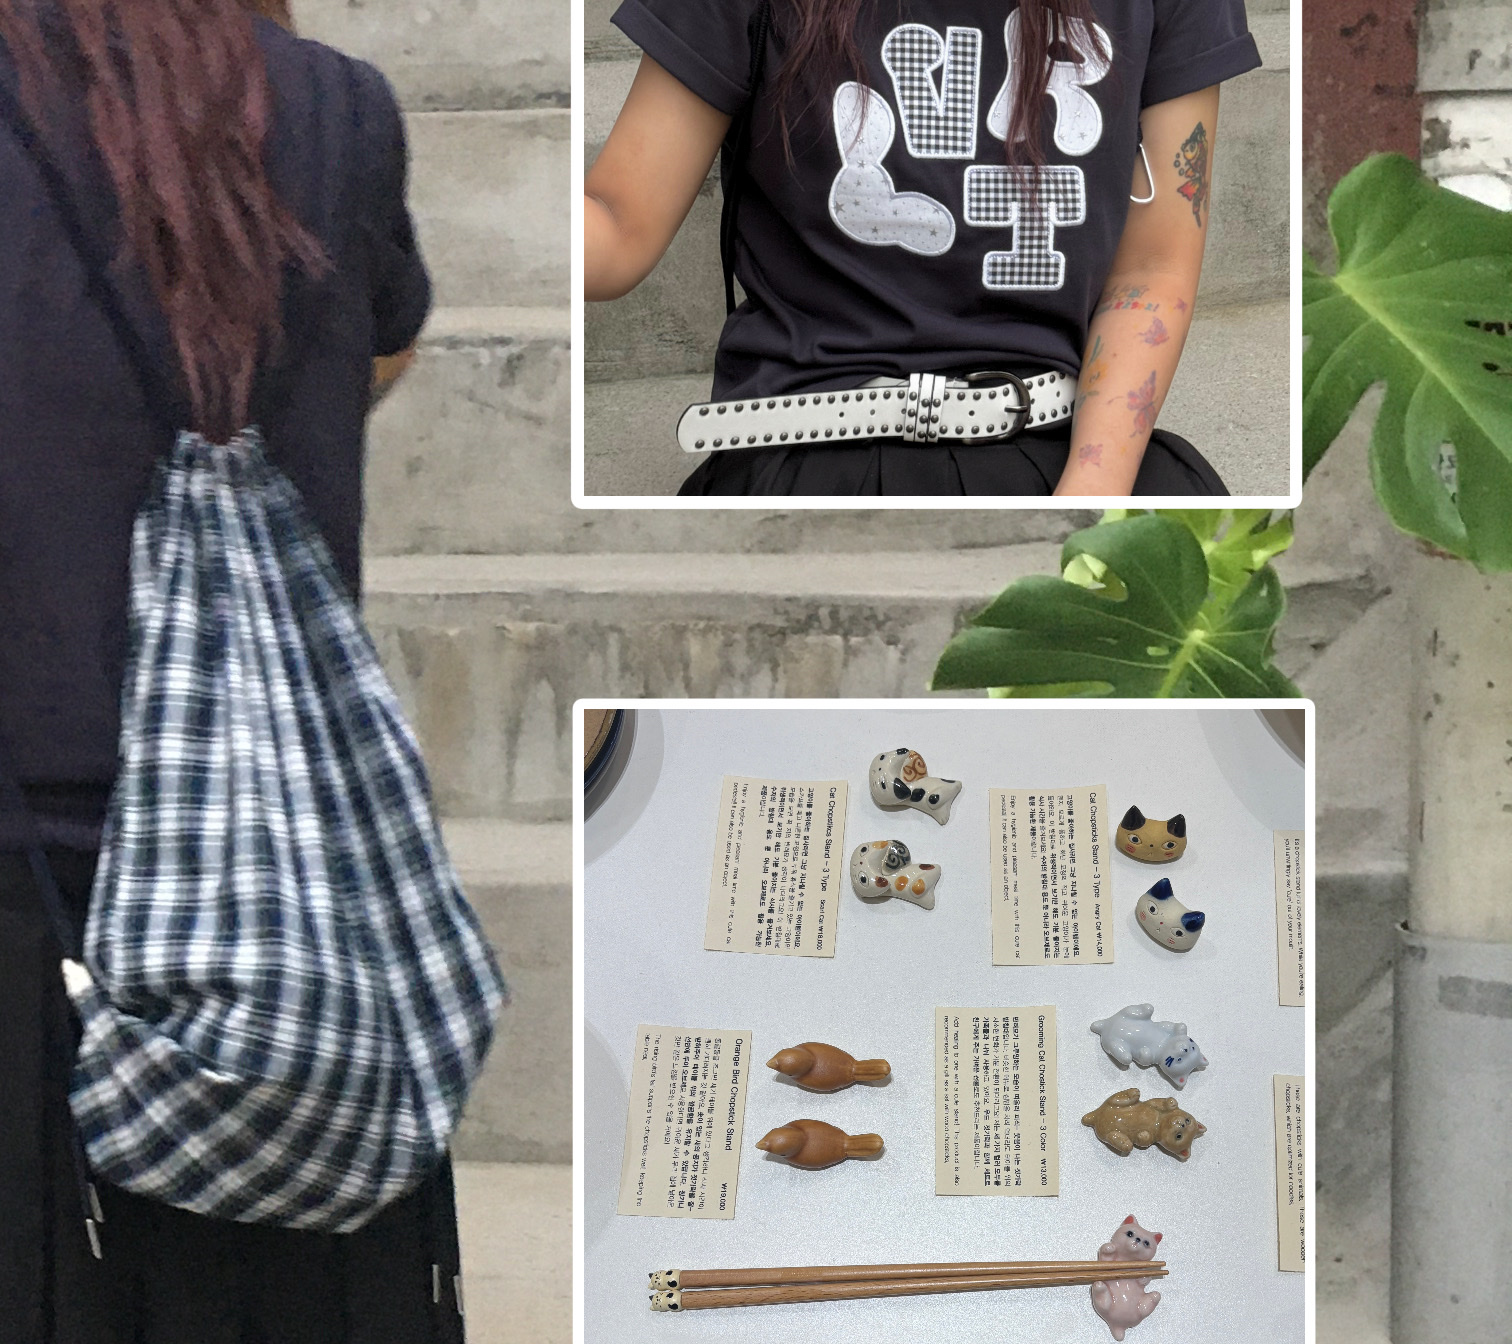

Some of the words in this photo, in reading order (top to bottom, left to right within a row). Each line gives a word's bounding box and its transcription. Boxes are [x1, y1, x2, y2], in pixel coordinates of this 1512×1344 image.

[963, 165, 1086, 291] T
[828, 786, 837, 799] Cat
[1089, 792, 1097, 804] Cat
[823, 838, 832, 859] Stand
[1091, 844, 1100, 864] Stand
[819, 874, 829, 892] Type
[1092, 881, 1101, 898] Type
[1037, 1014, 1045, 1048] Grooming
[732, 1038, 743, 1067] Orange
[731, 1068, 740, 1085] Bird
[727, 1086, 738, 1126] Chopstick
[1039, 1095, 1047, 1116] Stand
[724, 1127, 734, 1151] Stand
[1039, 1132, 1047, 1151] Color
